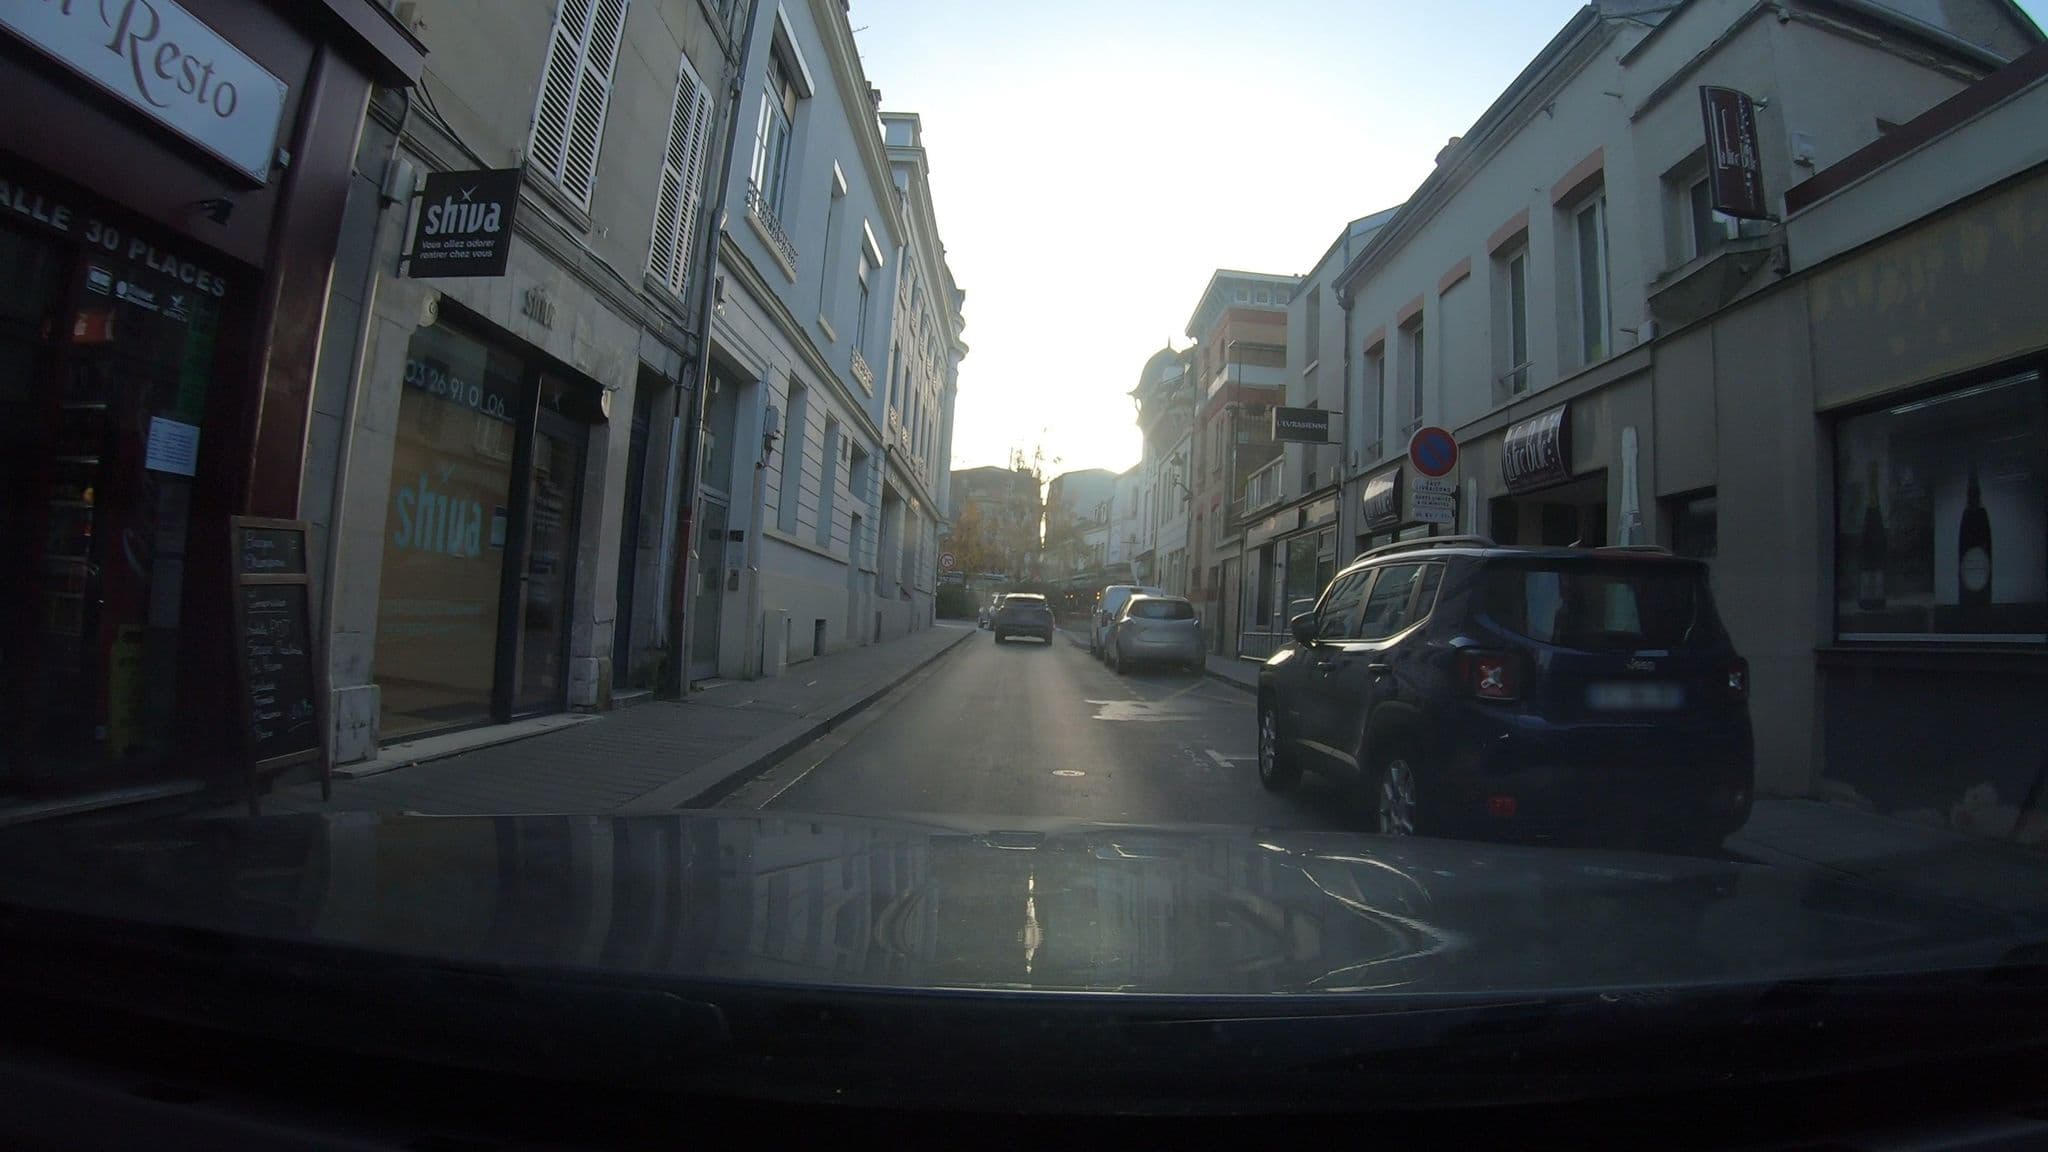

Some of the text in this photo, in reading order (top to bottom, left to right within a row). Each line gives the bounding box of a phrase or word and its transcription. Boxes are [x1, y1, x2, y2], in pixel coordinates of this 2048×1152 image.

[100, 0, 237, 118] Resto
[422, 240, 442, 249] Vous
[425, 195, 502, 235] shiva
[85, 217, 119, 251] 30
[127, 237, 226, 298] PLACES
[449, 249, 470, 259] chez
[472, 249, 493, 258] vous
[405, 359, 425, 387] 03
[430, 369, 447, 395] 26
[450, 377, 465, 402] 91
[487, 393, 505, 418] 06
[393, 472, 483, 558] shiva
